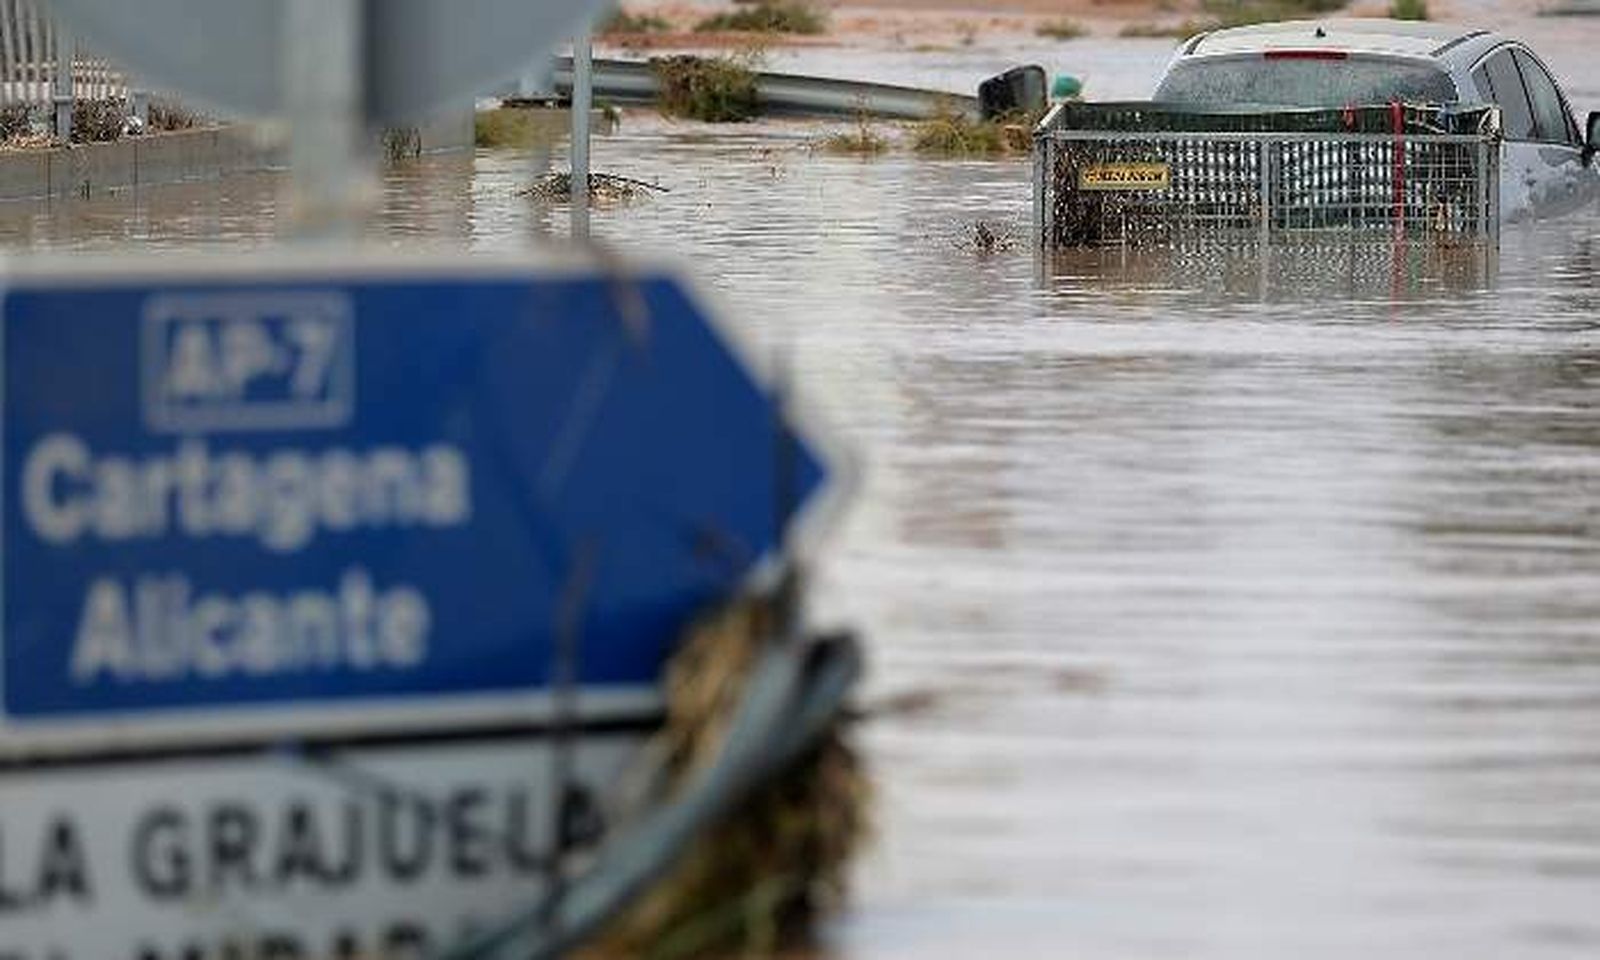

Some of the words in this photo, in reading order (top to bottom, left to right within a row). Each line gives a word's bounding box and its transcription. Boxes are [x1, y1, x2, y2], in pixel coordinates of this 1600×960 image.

[160, 316, 338, 402] AP-7
[21, 432, 471, 552] Cartagena
[68, 565, 432, 686] Alicante
